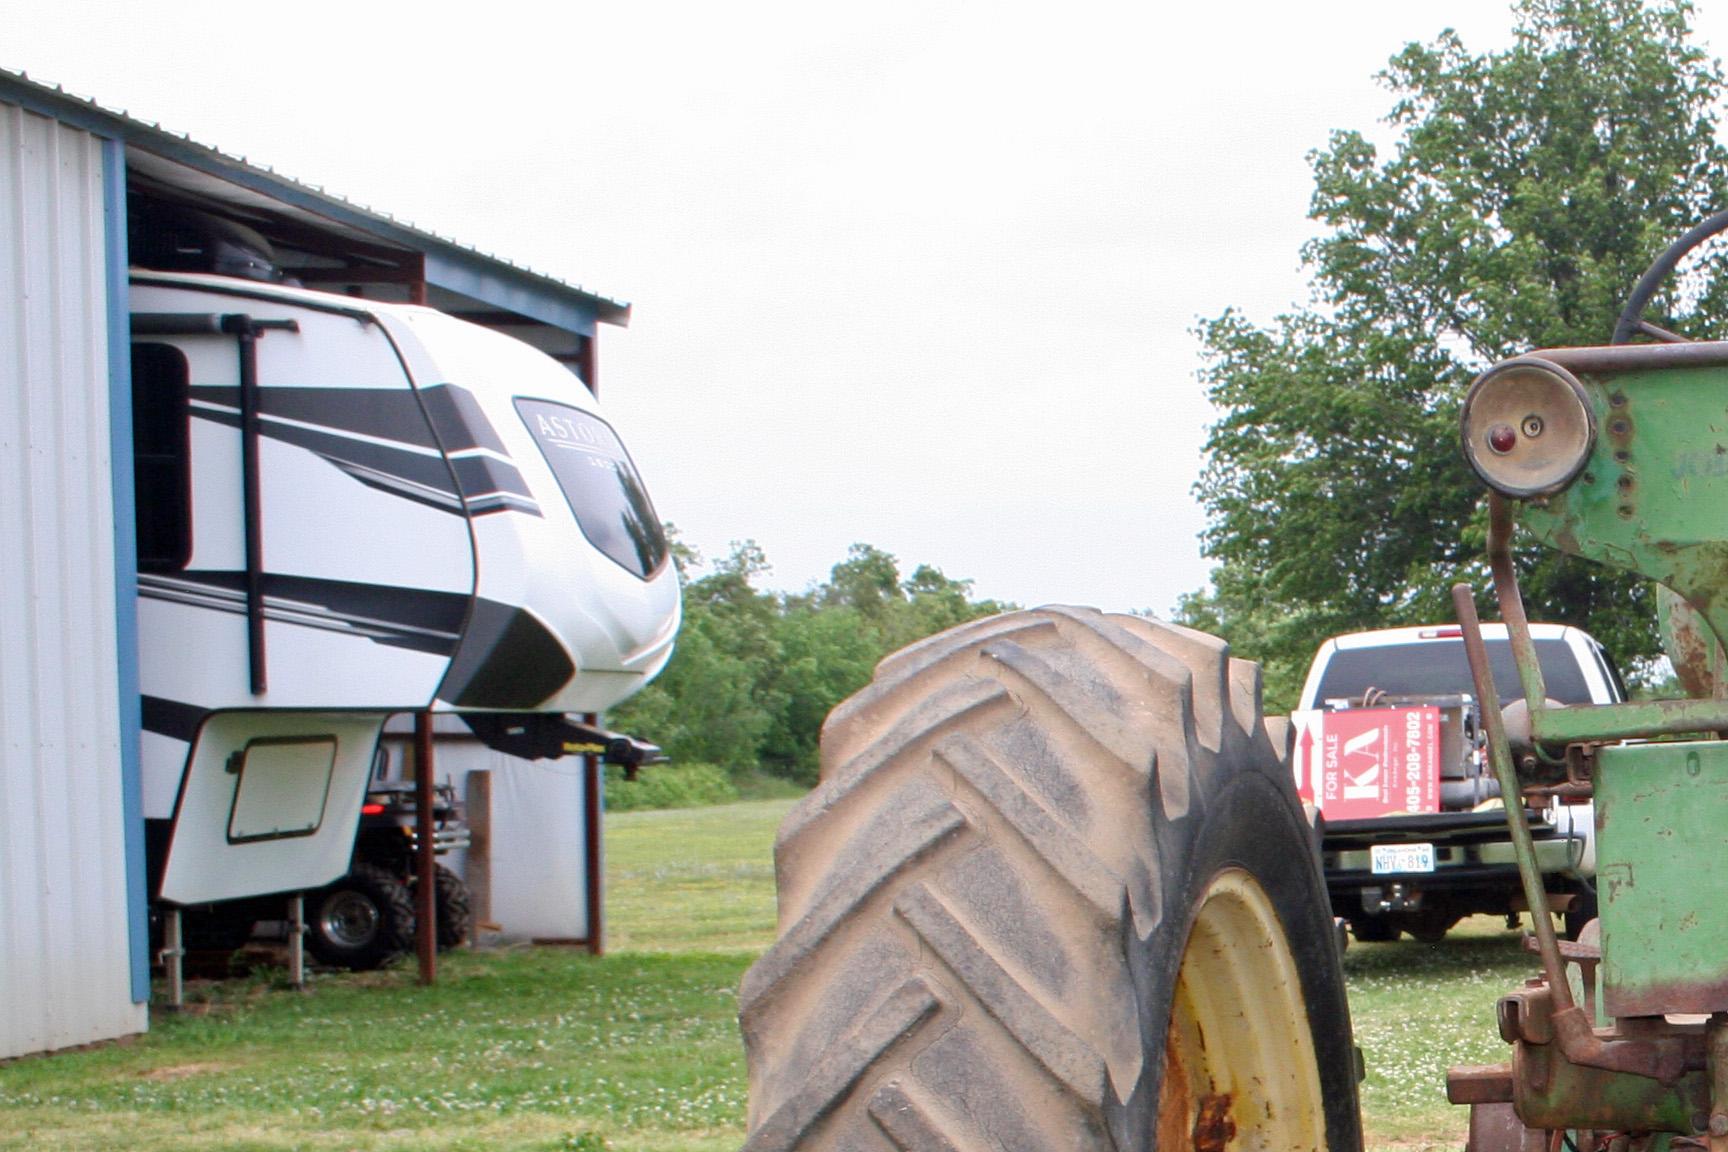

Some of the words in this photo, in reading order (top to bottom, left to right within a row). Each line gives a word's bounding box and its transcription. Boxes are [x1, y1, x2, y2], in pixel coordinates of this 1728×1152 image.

[1325, 733, 1338, 769] SALE
[1343, 727, 1380, 803] KA
[1325, 771, 1338, 801] FOR
